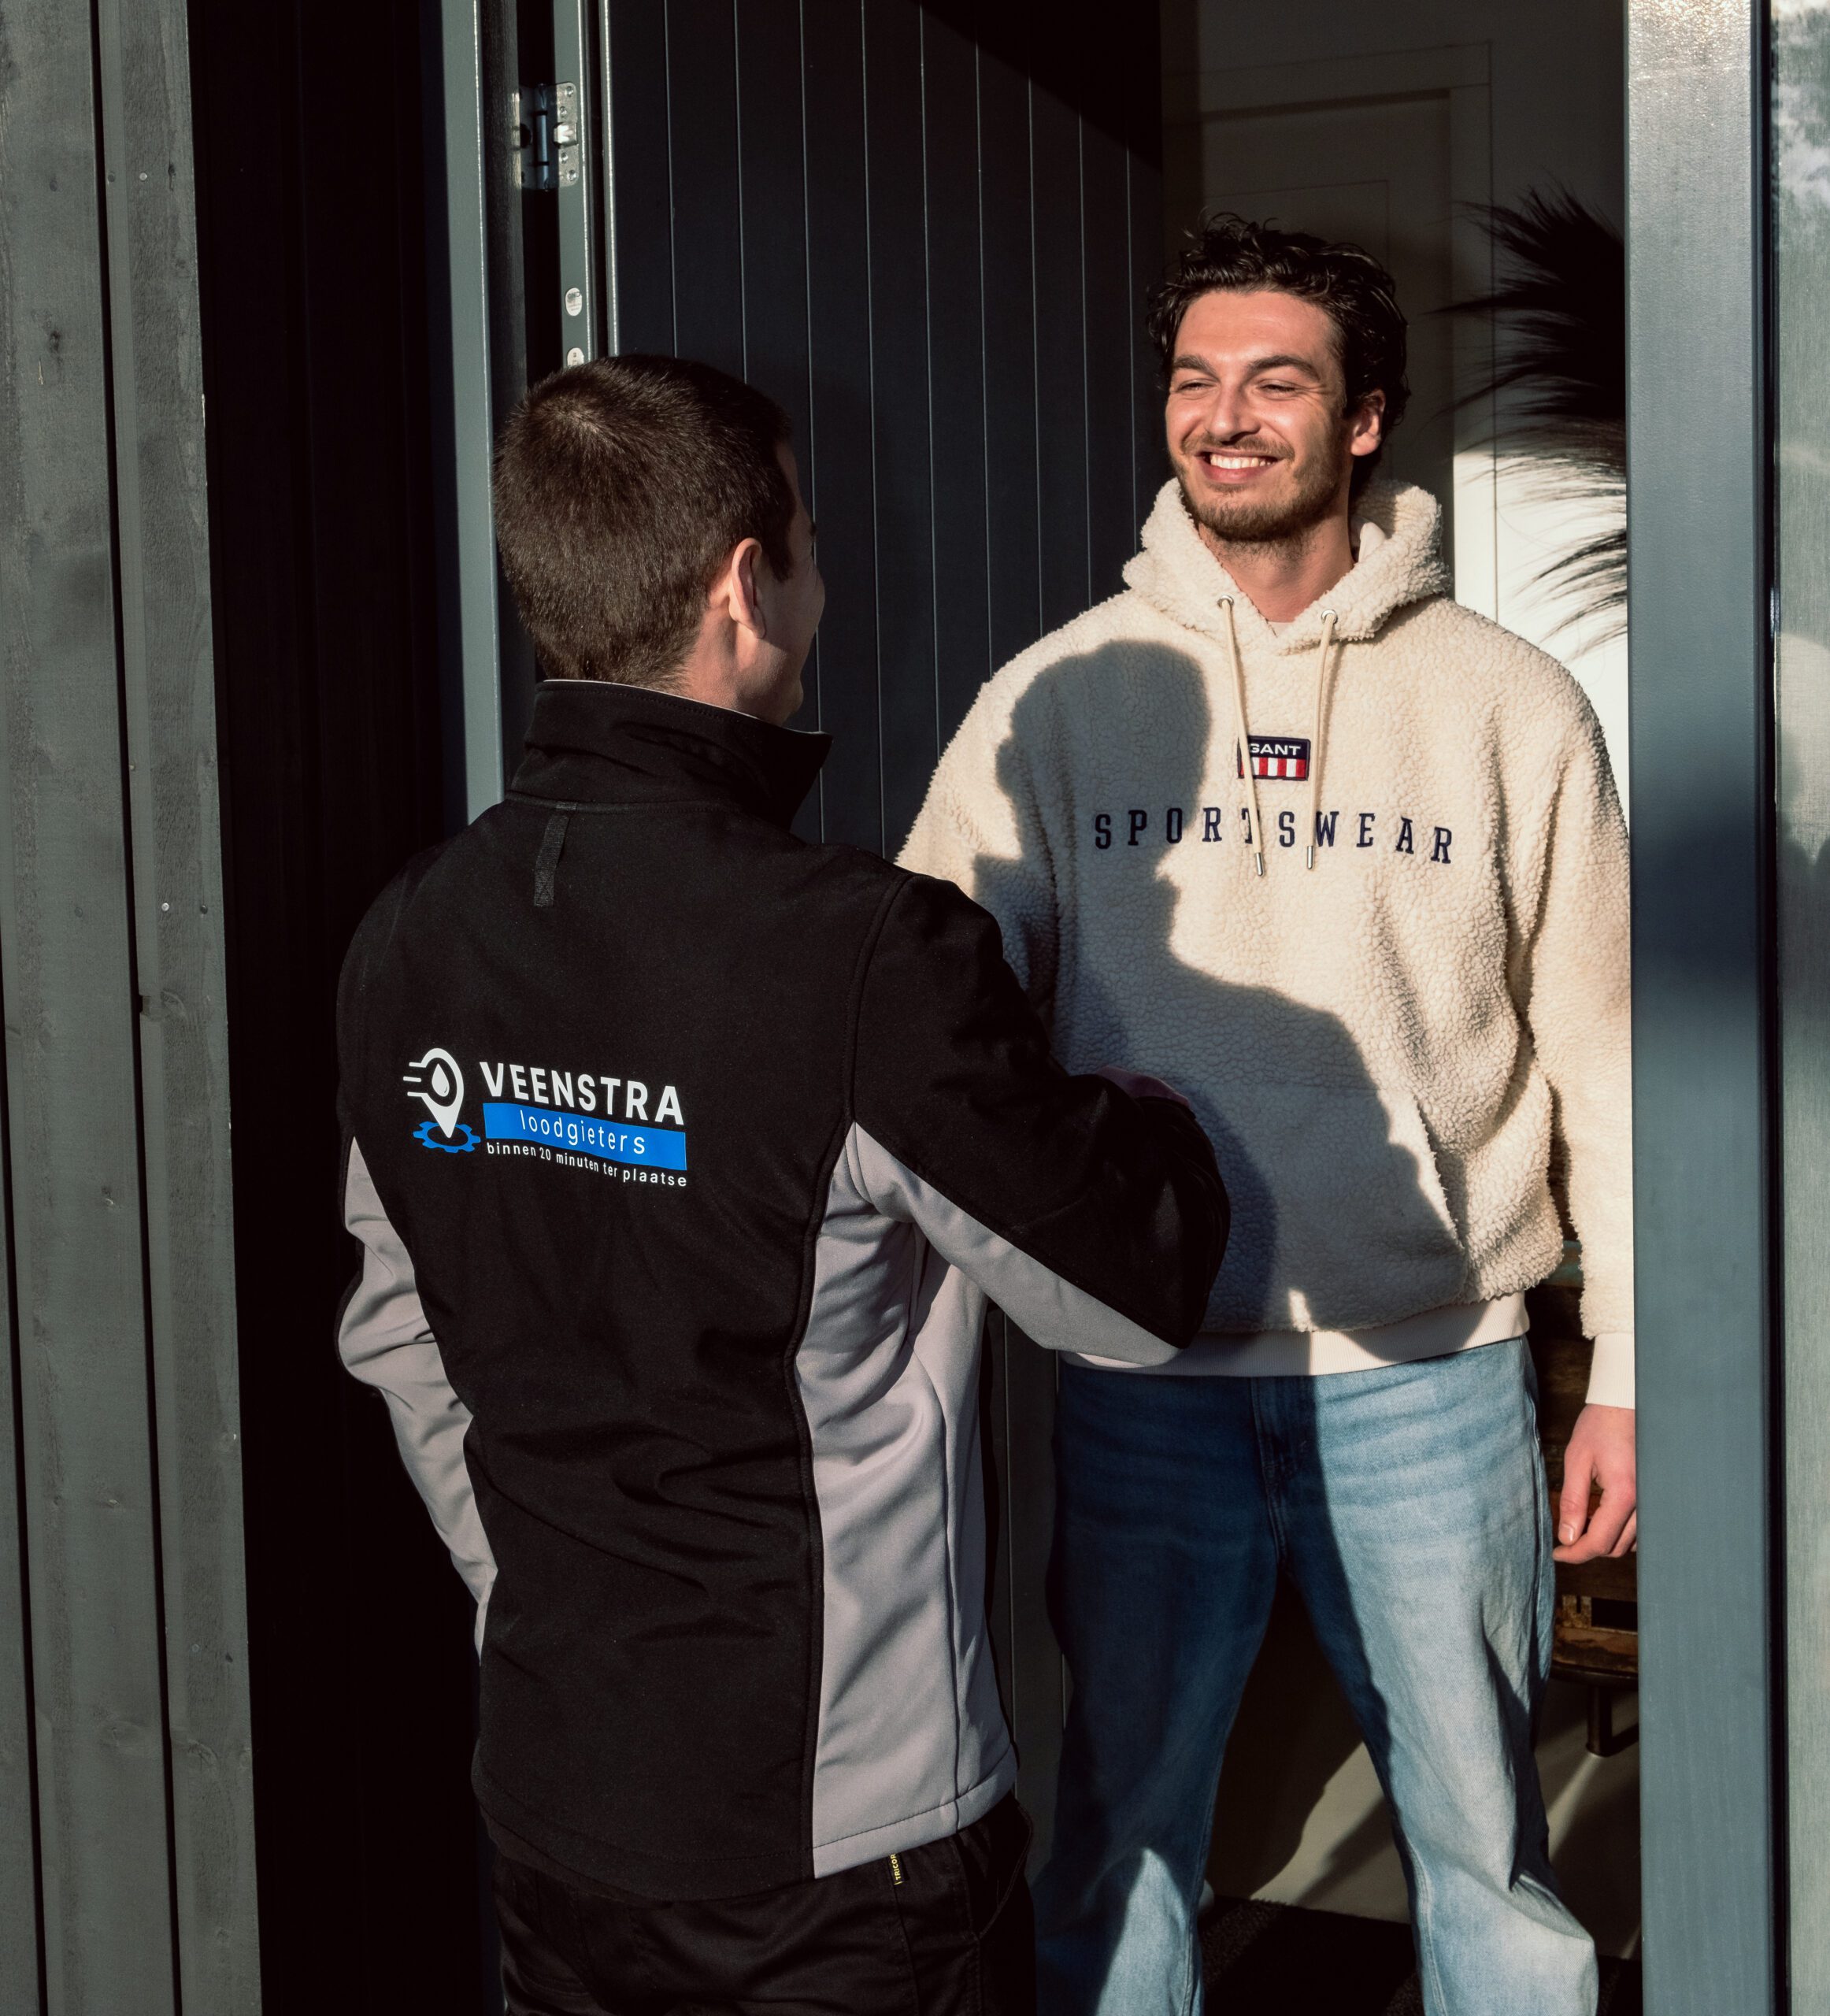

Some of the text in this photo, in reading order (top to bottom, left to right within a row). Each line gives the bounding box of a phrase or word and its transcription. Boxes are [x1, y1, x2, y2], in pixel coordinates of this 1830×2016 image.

[1250, 743, 1301, 756] GANT
[480, 1062, 684, 1125] VEENSTRA
[520, 1110, 646, 1154] loodgieters
[486, 1142, 687, 1187] binnen 20 minuten ter plaatse
